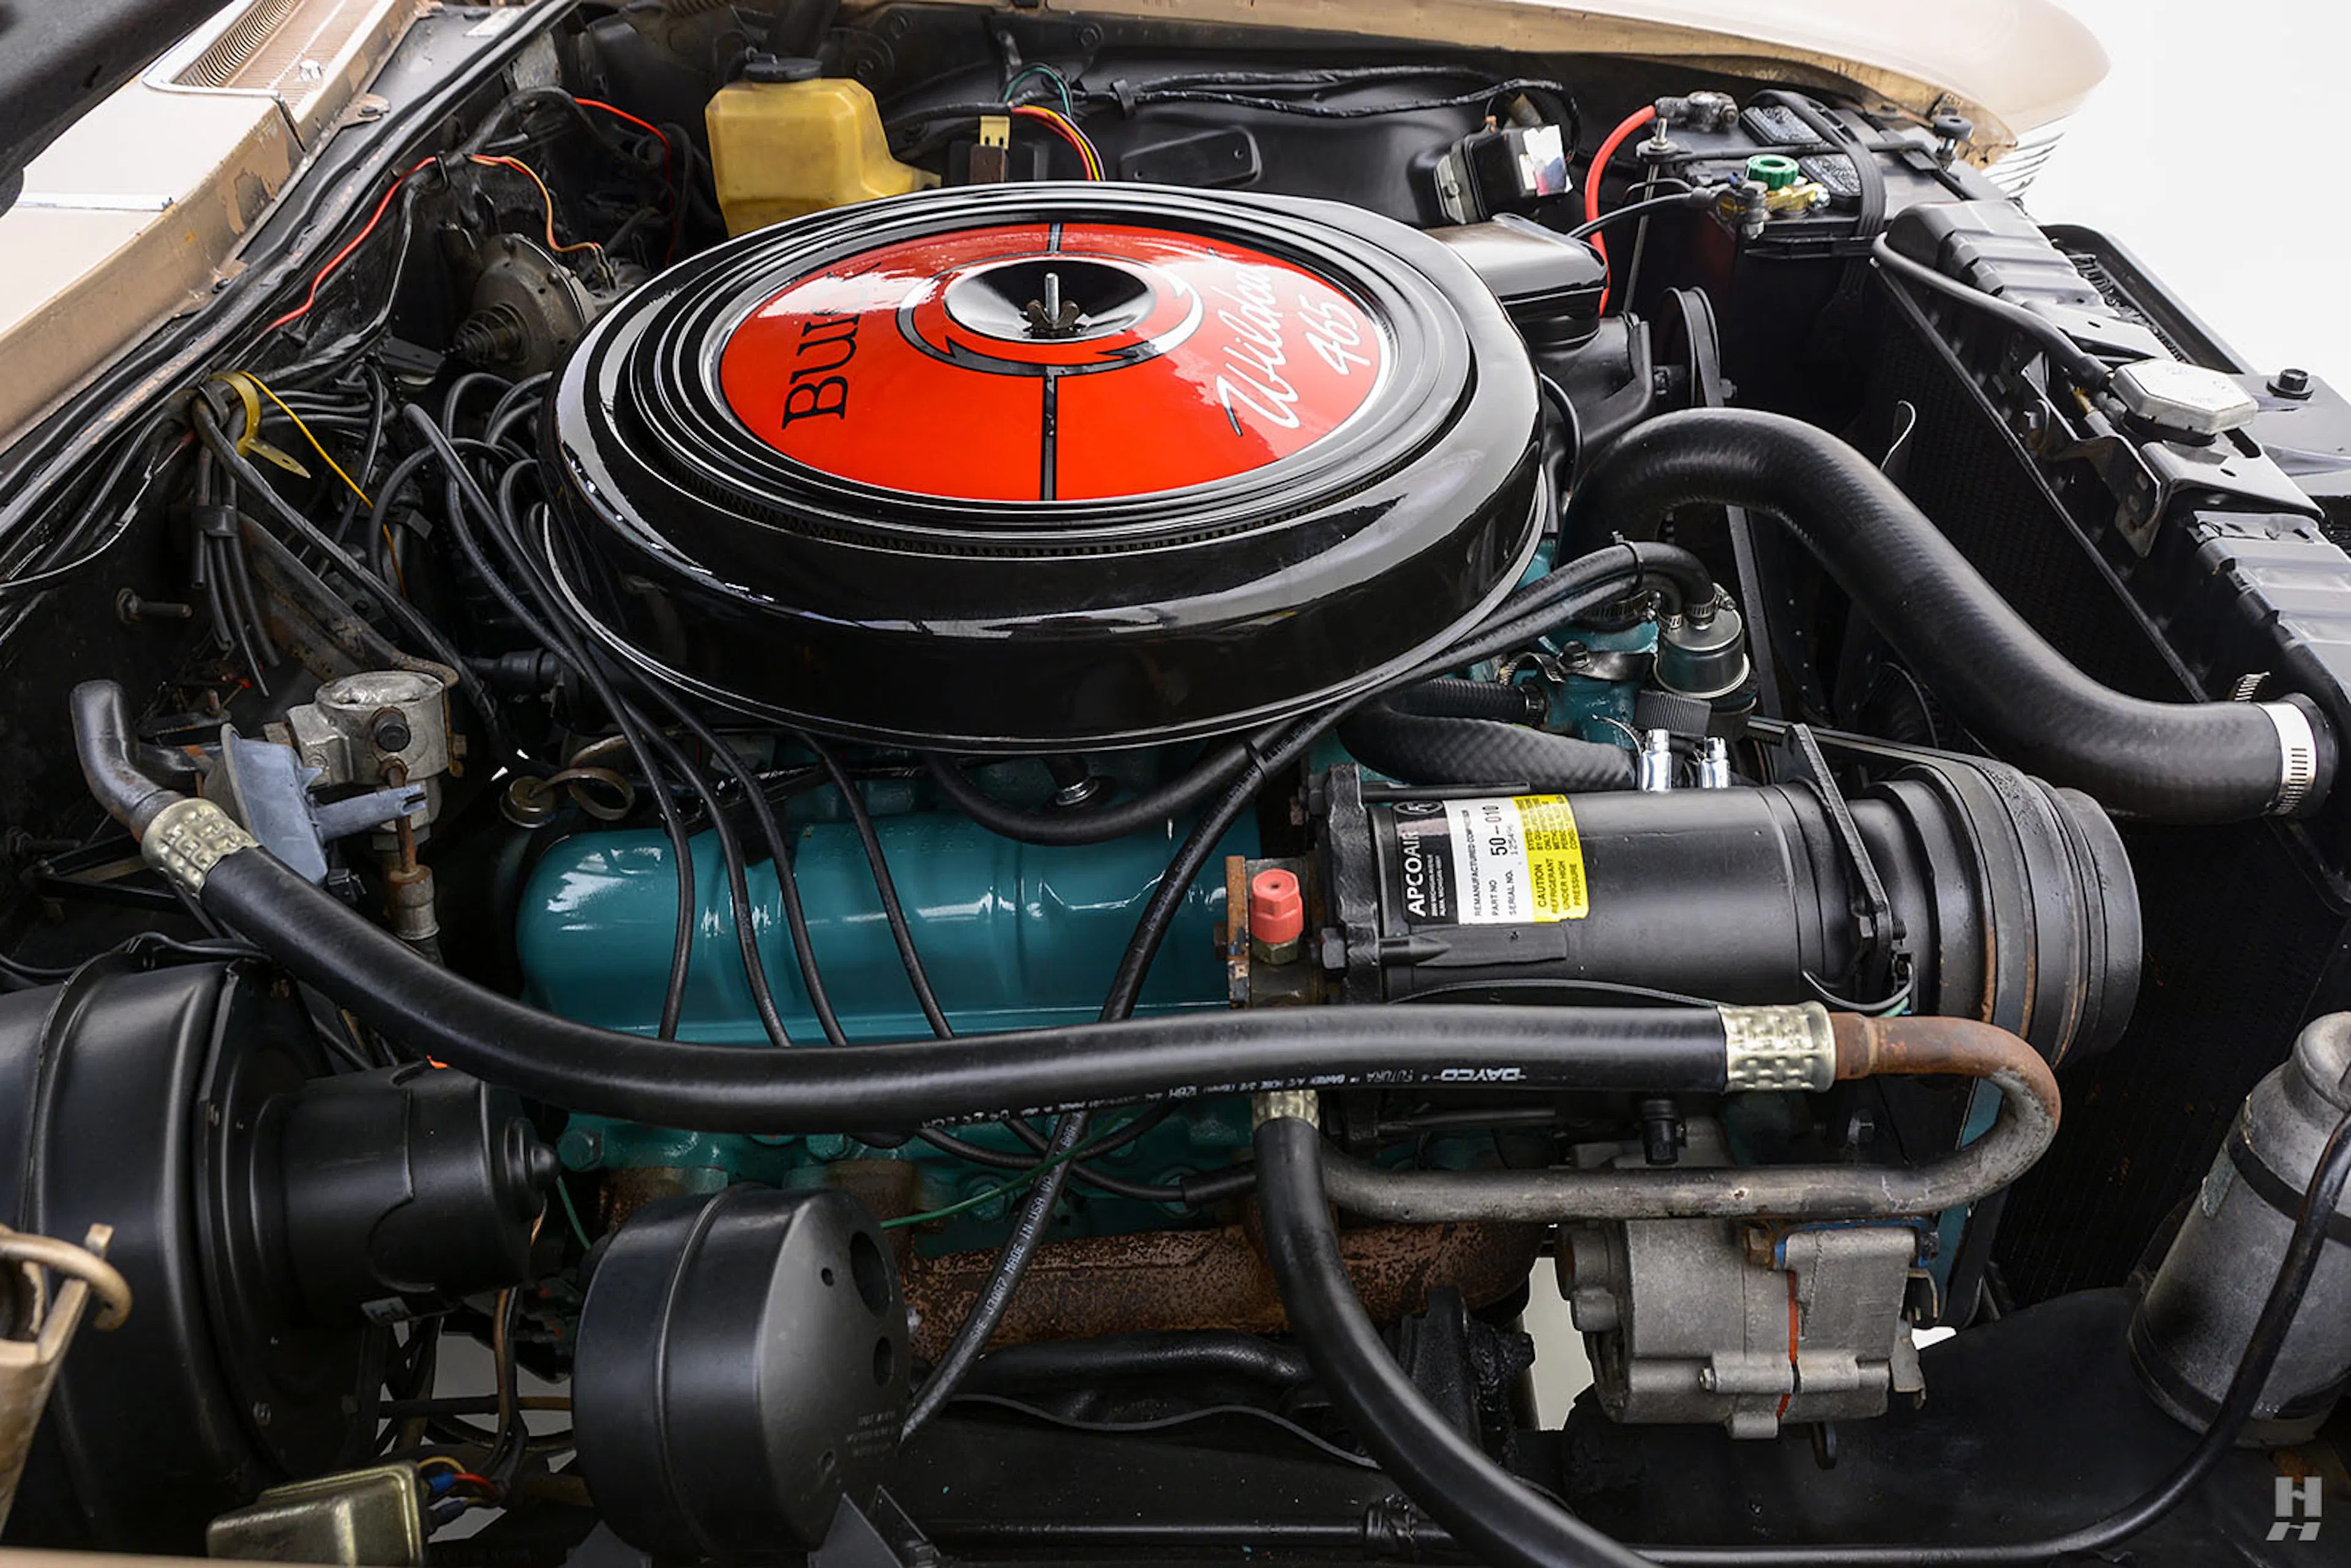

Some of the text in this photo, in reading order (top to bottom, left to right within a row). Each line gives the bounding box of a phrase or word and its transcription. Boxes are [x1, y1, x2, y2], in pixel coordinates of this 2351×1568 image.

[781, 262, 882, 430] BUI
[1210, 247, 1301, 437] Wildca
[1297, 294, 1372, 375] 465
[1461, 809, 1475, 842] COMPOR
[1401, 831, 1427, 917] APCOAIR
[1534, 864, 1547, 907] CAUTION
[1546, 858, 1559, 913] REFRIGERANT
[1558, 860, 1570, 910] UNDER HIGH
[1569, 864, 1582, 906] PRESSURE
[1490, 895, 1499, 916] PART
[1507, 885, 1517, 916] SERIAL
[1366, 1069, 1414, 1082] FUTURA
[1440, 1067, 1521, 1081] DAYCO
[970, 1318, 988, 1341] SAE
[1004, 1244, 1025, 1275] MADE
[1018, 1223, 1035, 1241] IN
[1029, 1196, 1048, 1221] USA
